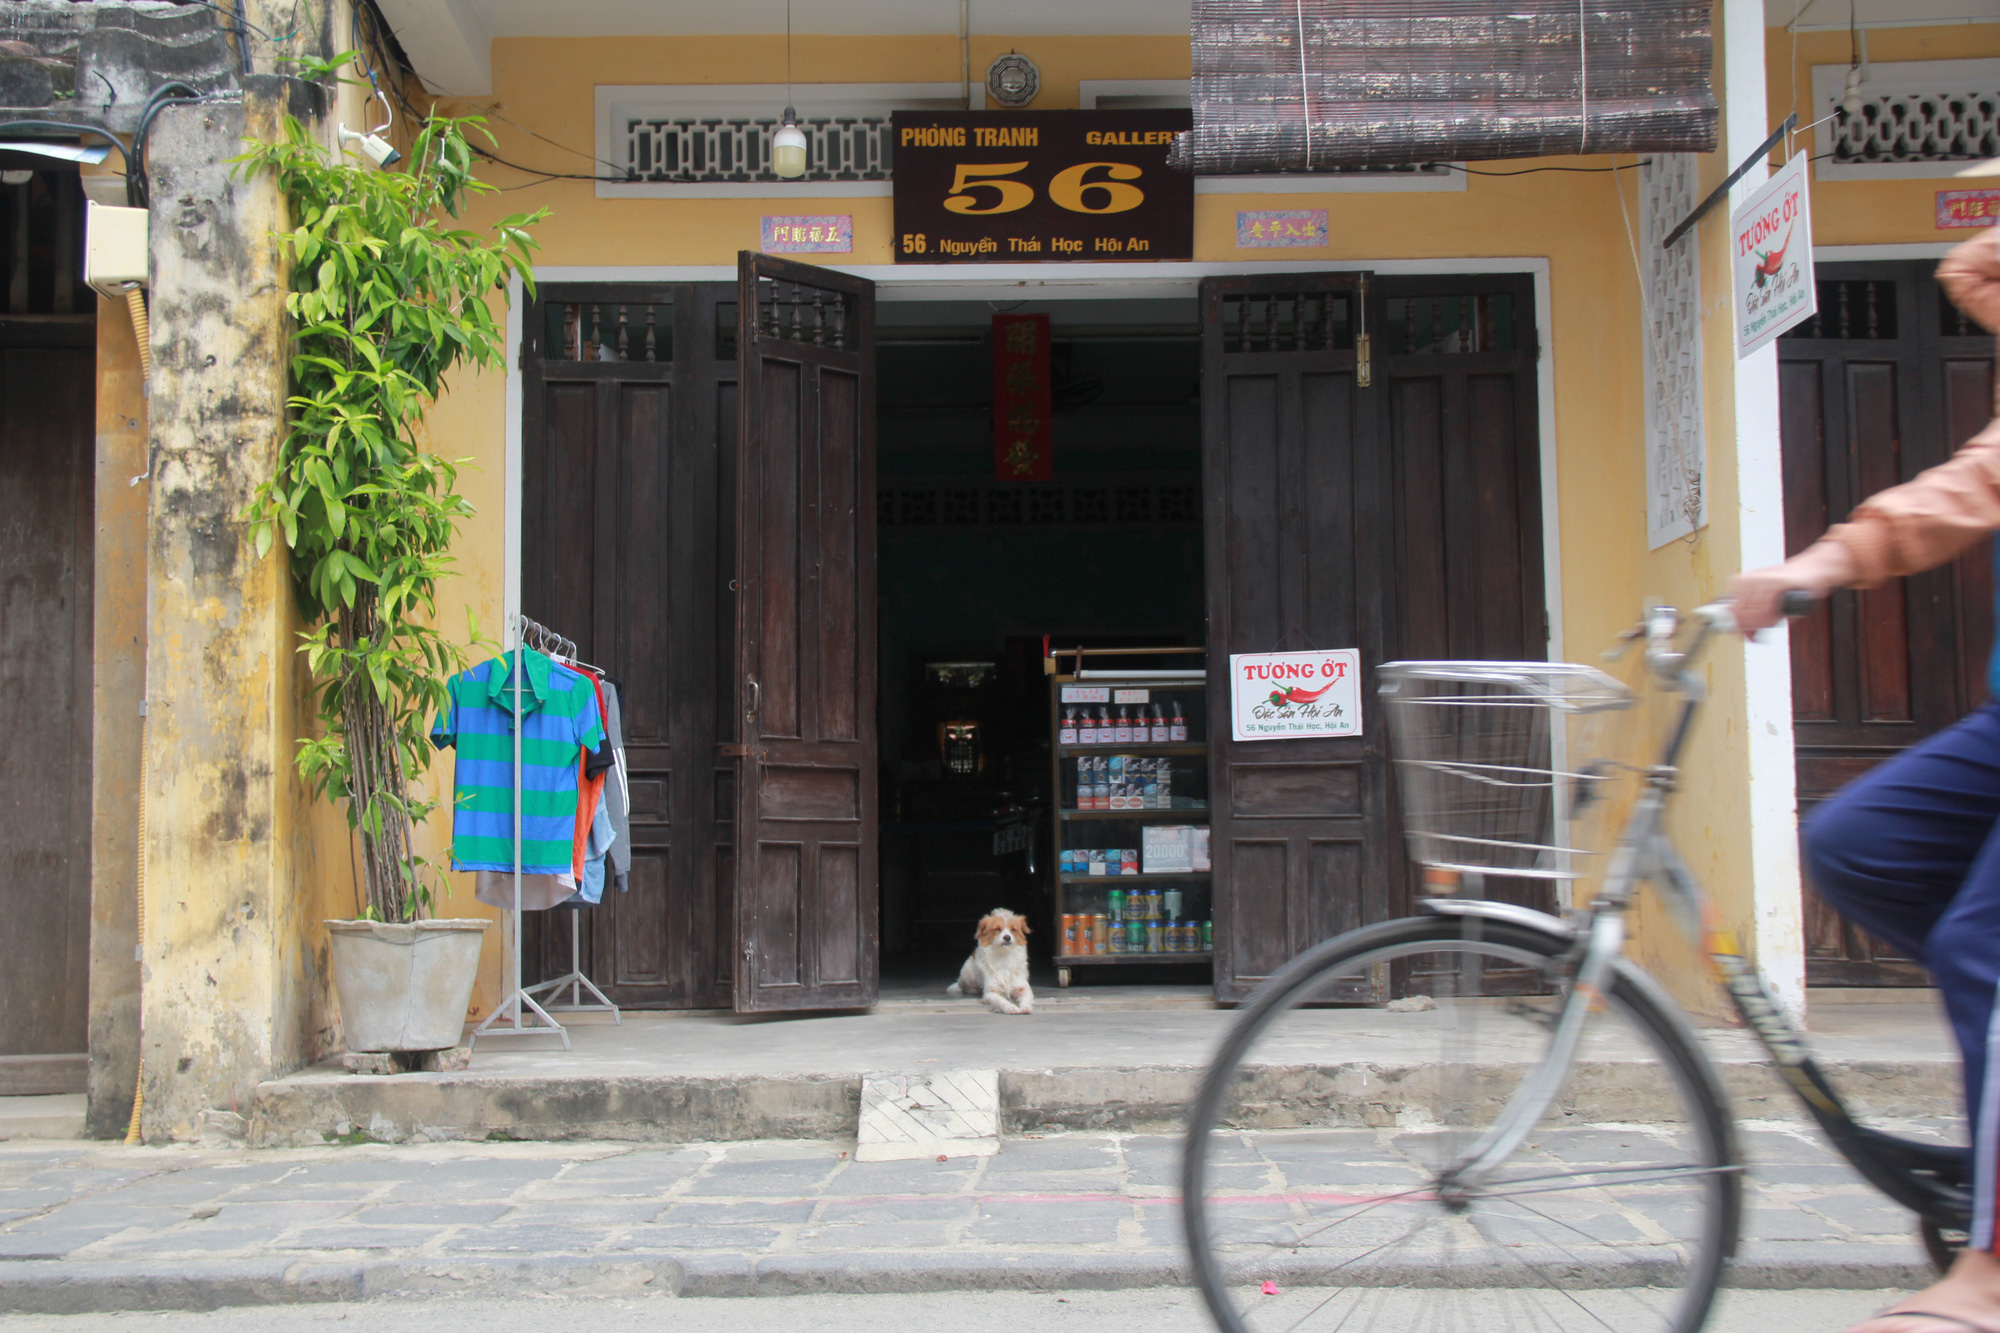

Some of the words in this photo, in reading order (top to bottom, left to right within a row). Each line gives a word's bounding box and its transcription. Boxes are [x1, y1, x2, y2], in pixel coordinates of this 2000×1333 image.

[901, 123, 966, 147] PHÒNG
[973, 127, 1039, 147] TRANH
[943, 161, 1145, 215] 56
[1738, 207, 1780, 257] TƯƠNG
[1782, 191, 1799, 223] ỚT
[1051, 237, 1084, 255] Học
[1126, 237, 1150, 251] An
[1243, 661, 1315, 680] TƯƠNG
[1321, 658, 1347, 677] ỚT
[1252, 705, 1275, 721] Đặc
[1276, 705, 1296, 720] Sản
[1297, 703, 1323, 720] Hội
[1322, 702, 1343, 718] An
[1246, 724, 1256, 732] 56
[1339, 721, 1350, 729] An
